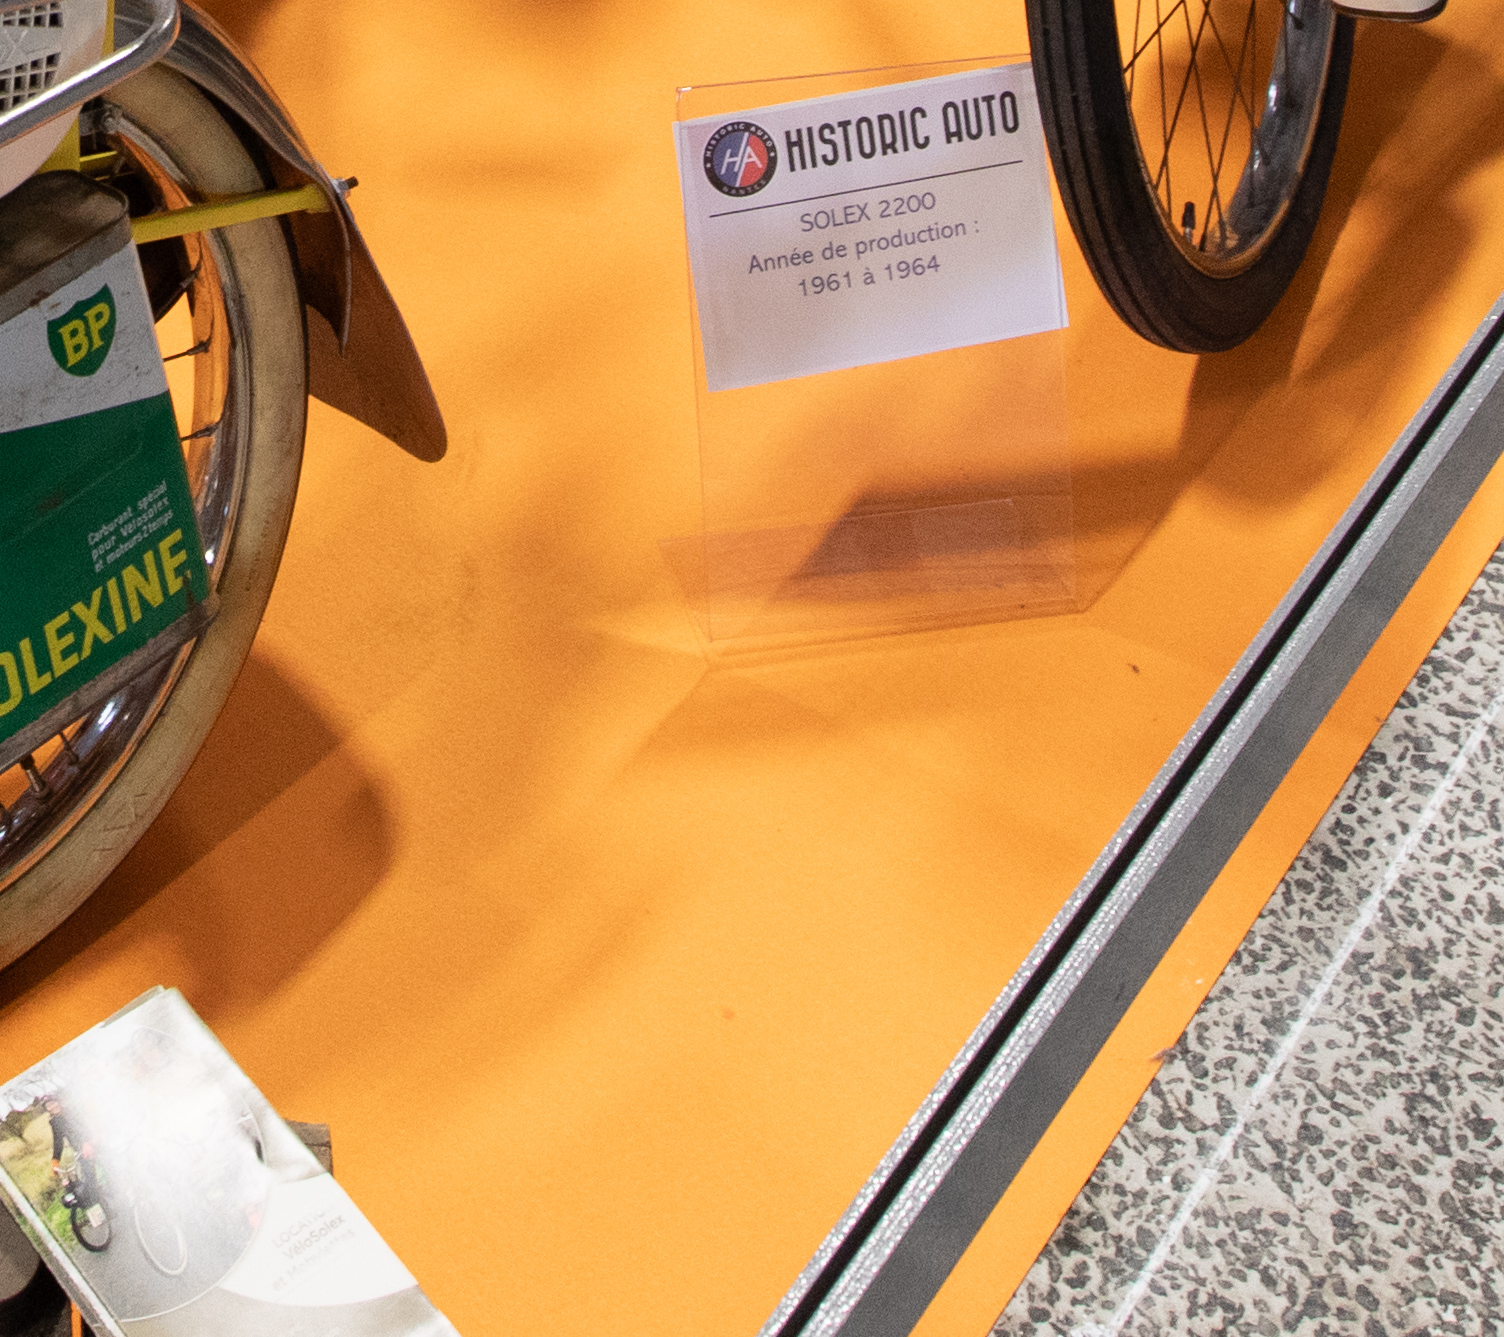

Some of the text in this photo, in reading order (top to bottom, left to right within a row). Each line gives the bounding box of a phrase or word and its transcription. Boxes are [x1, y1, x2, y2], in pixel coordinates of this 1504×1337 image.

[784, 90, 1020, 173] HISTORIC AUTO
[799, 192, 936, 233] SOLEX 2200
[748, 238, 814, 274] Année
[821, 240, 849, 261] de
[855, 220, 967, 257] production
[798, 254, 941, 298] 1961 à 1964
[57, 302, 114, 369] BP
